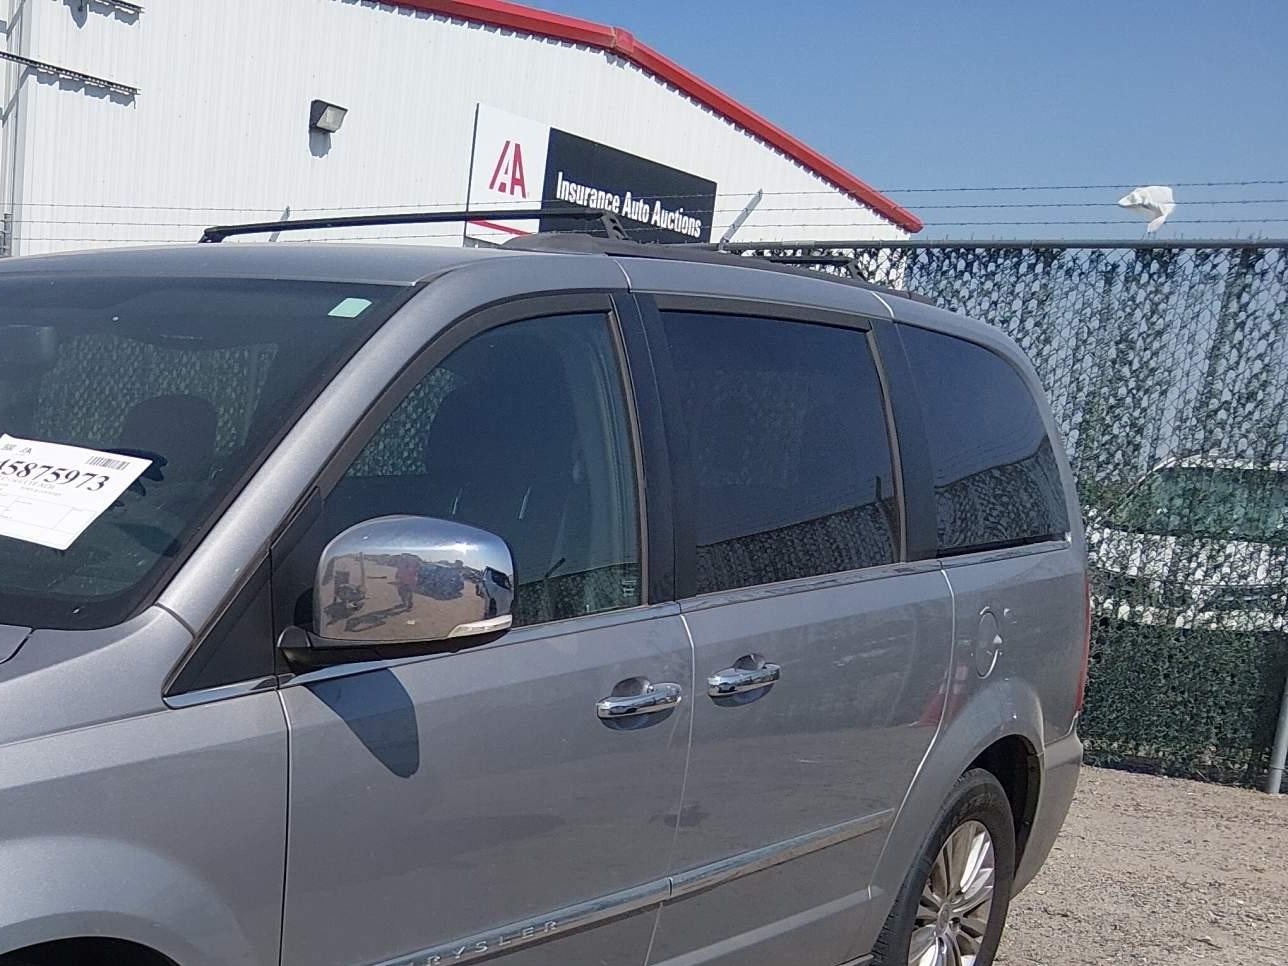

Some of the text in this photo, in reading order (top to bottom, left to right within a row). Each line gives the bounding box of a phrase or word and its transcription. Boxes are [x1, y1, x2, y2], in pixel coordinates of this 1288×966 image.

[556, 171, 702, 238] Insurance Auto Auctions
